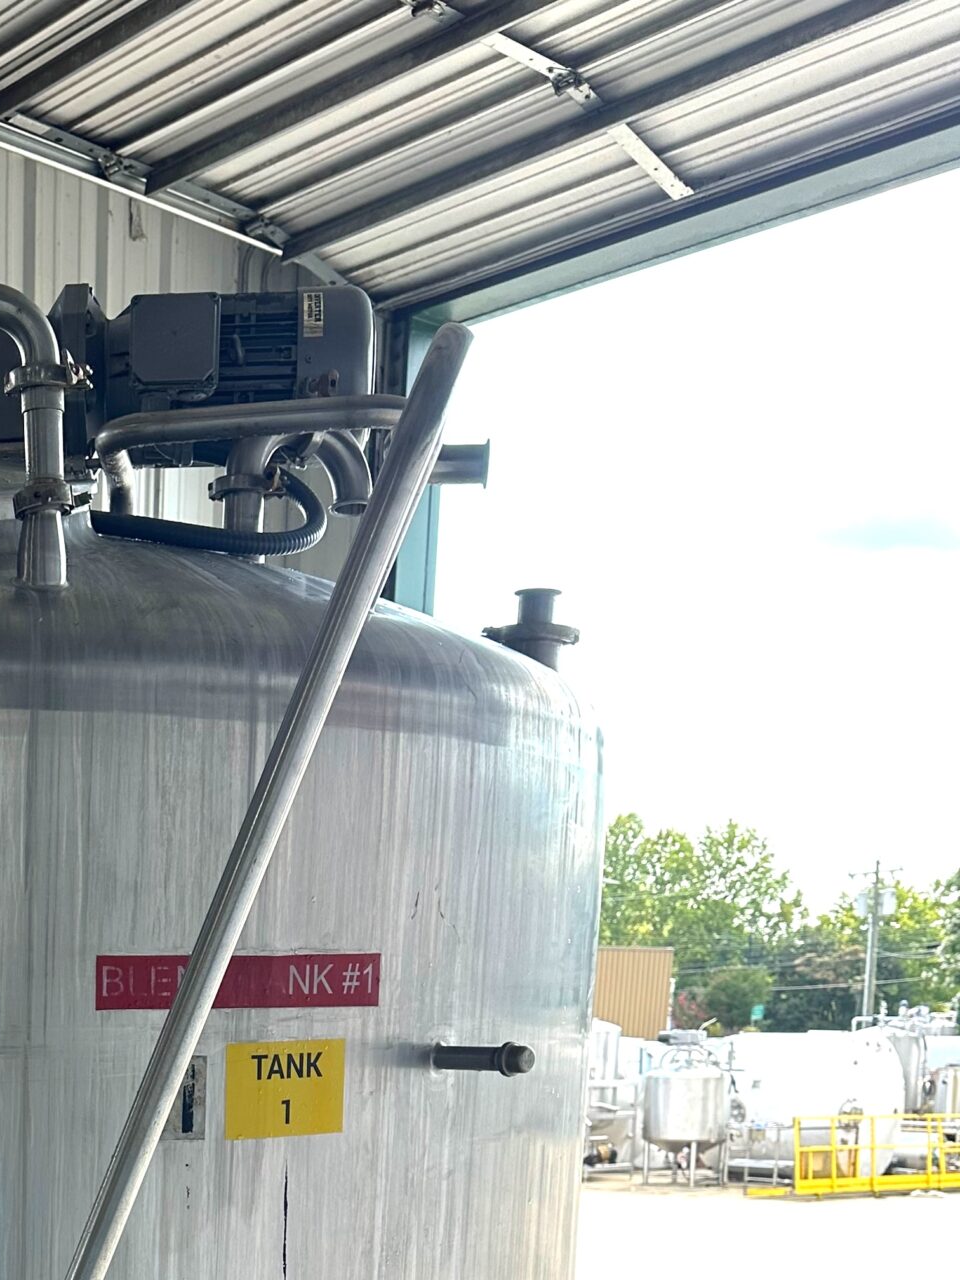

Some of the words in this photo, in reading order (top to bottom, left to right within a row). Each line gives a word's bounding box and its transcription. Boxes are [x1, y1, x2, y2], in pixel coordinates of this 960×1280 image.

[342, 963, 374, 994] #1
[251, 1052, 323, 1080] TANK
[281, 1099, 292, 1125] 1
